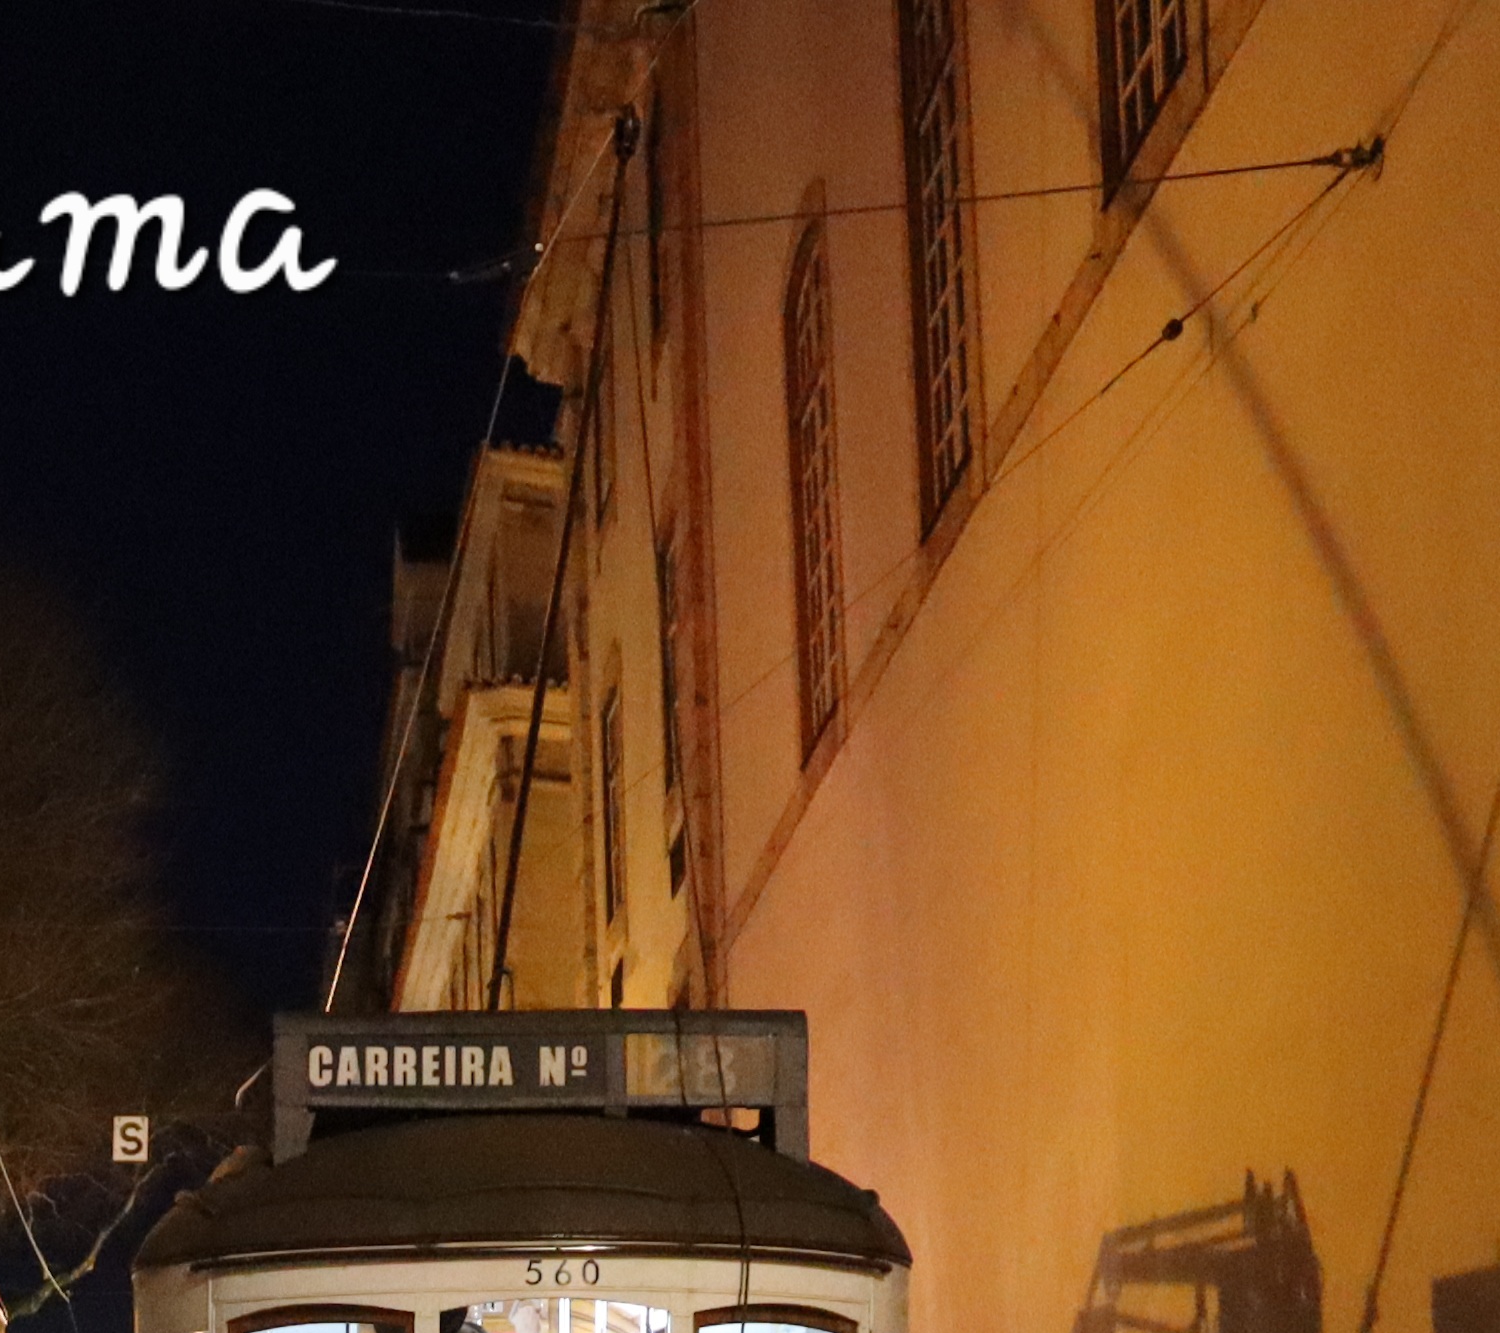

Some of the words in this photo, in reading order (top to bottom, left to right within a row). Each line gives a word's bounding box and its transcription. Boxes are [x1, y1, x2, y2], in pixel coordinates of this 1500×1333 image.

[308, 1045, 514, 1087] CARREIRA
[538, 1045, 588, 1087] Nº
[120, 1121, 143, 1155] S
[525, 1257, 599, 1286] 560
